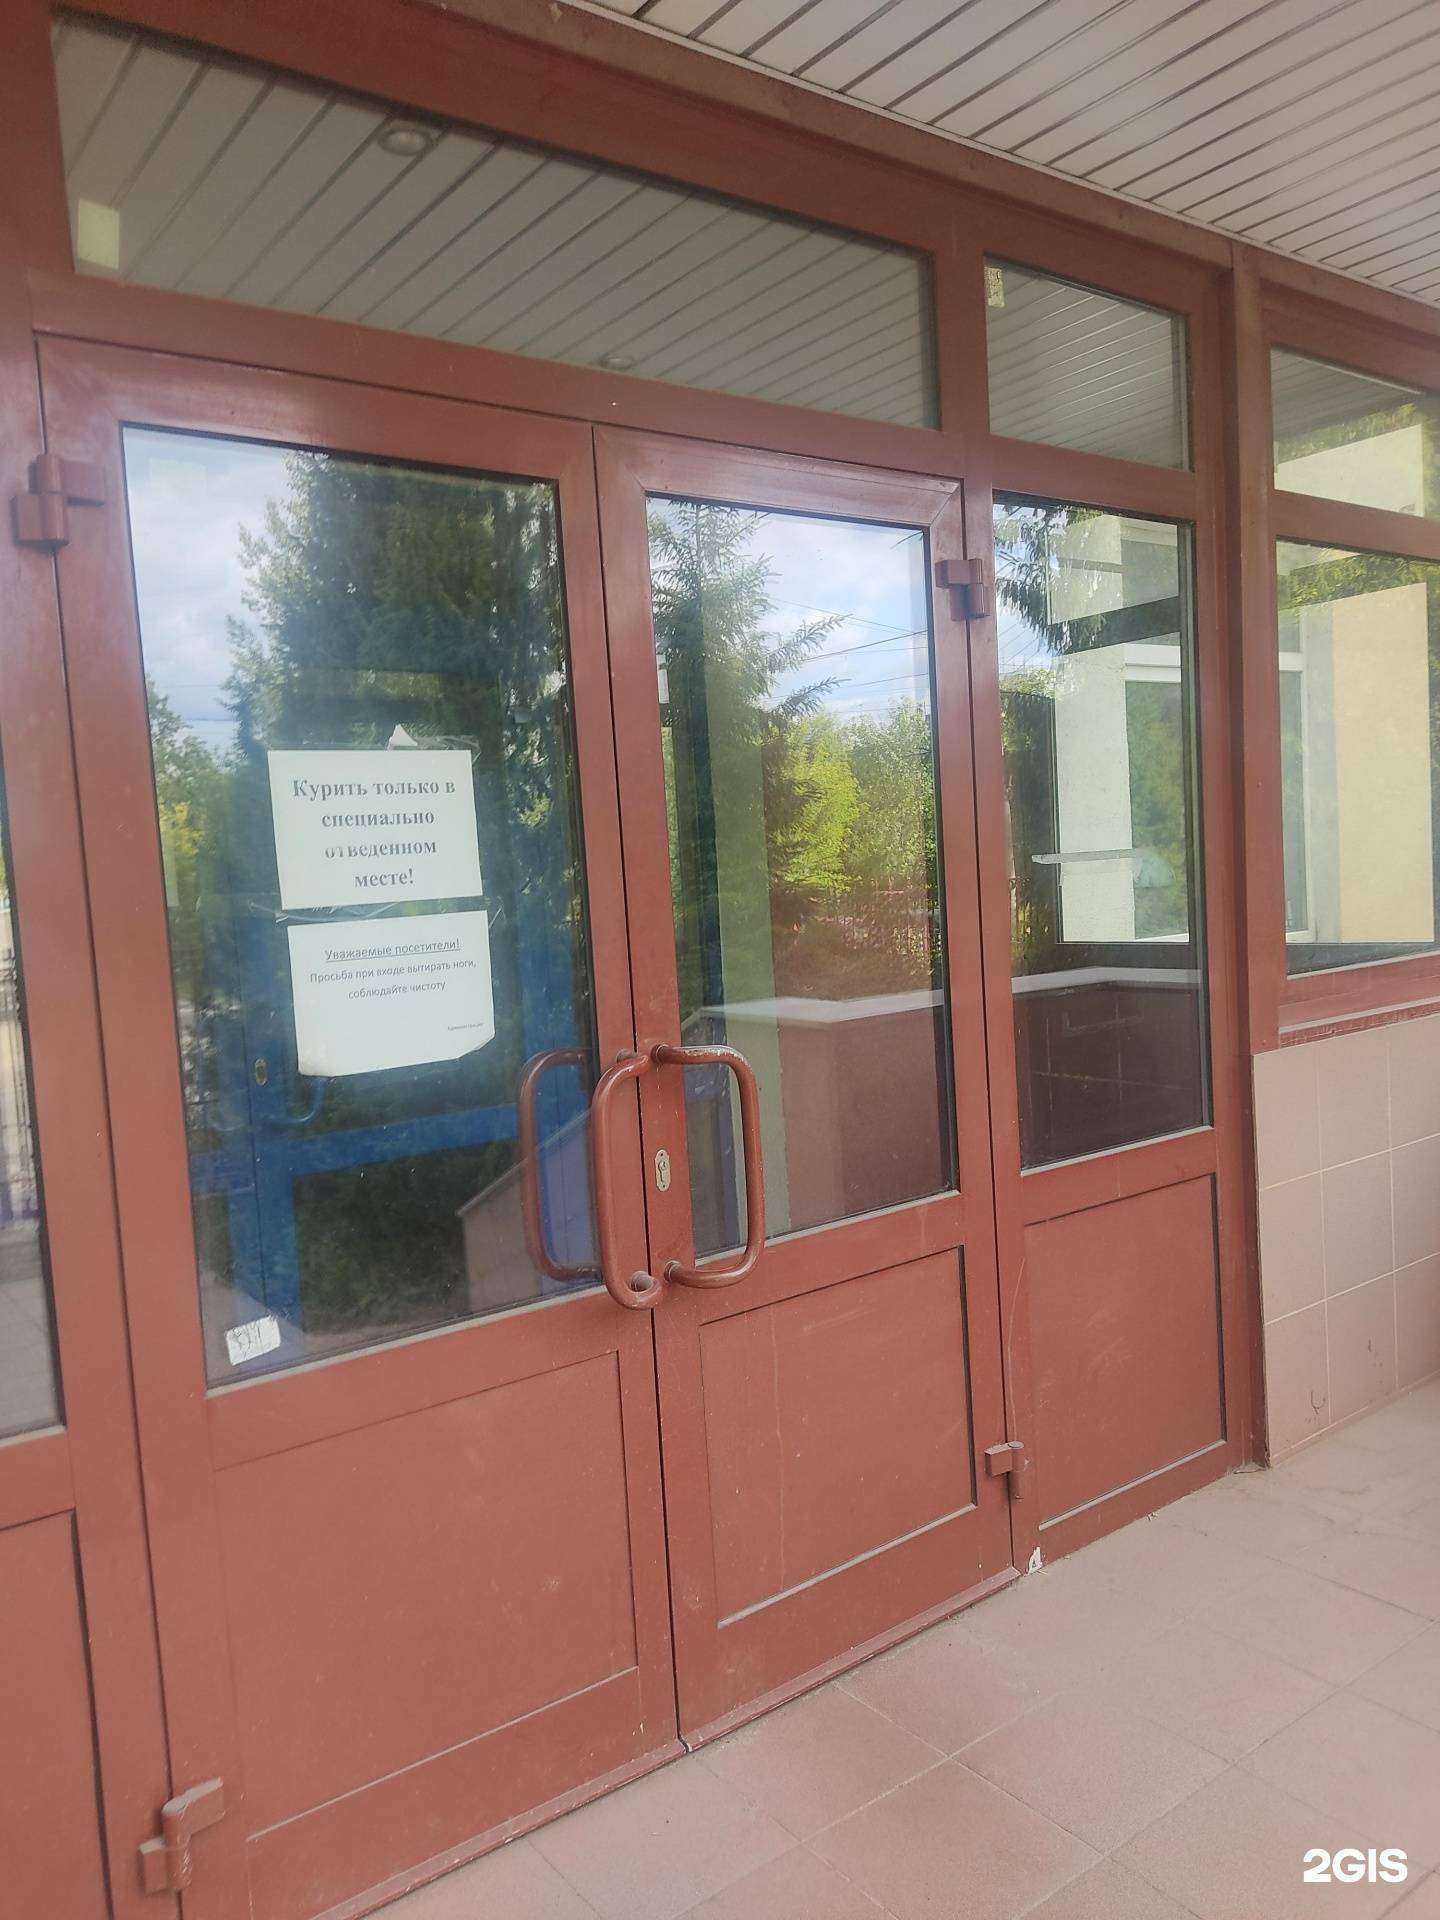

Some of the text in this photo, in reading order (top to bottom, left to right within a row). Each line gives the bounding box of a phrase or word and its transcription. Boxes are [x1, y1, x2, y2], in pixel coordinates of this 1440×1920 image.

[292, 778, 456, 801] Курить только в
[322, 811, 435, 828] специально
[325, 841, 437, 859] отведенном
[354, 868, 414, 888] месте!
[324, 938, 460, 961] Уважаемые посетители!
[309, 960, 477, 983] Просьба при входе вытирать ноги,
[348, 981, 446, 999] соблюдайте чистоту
